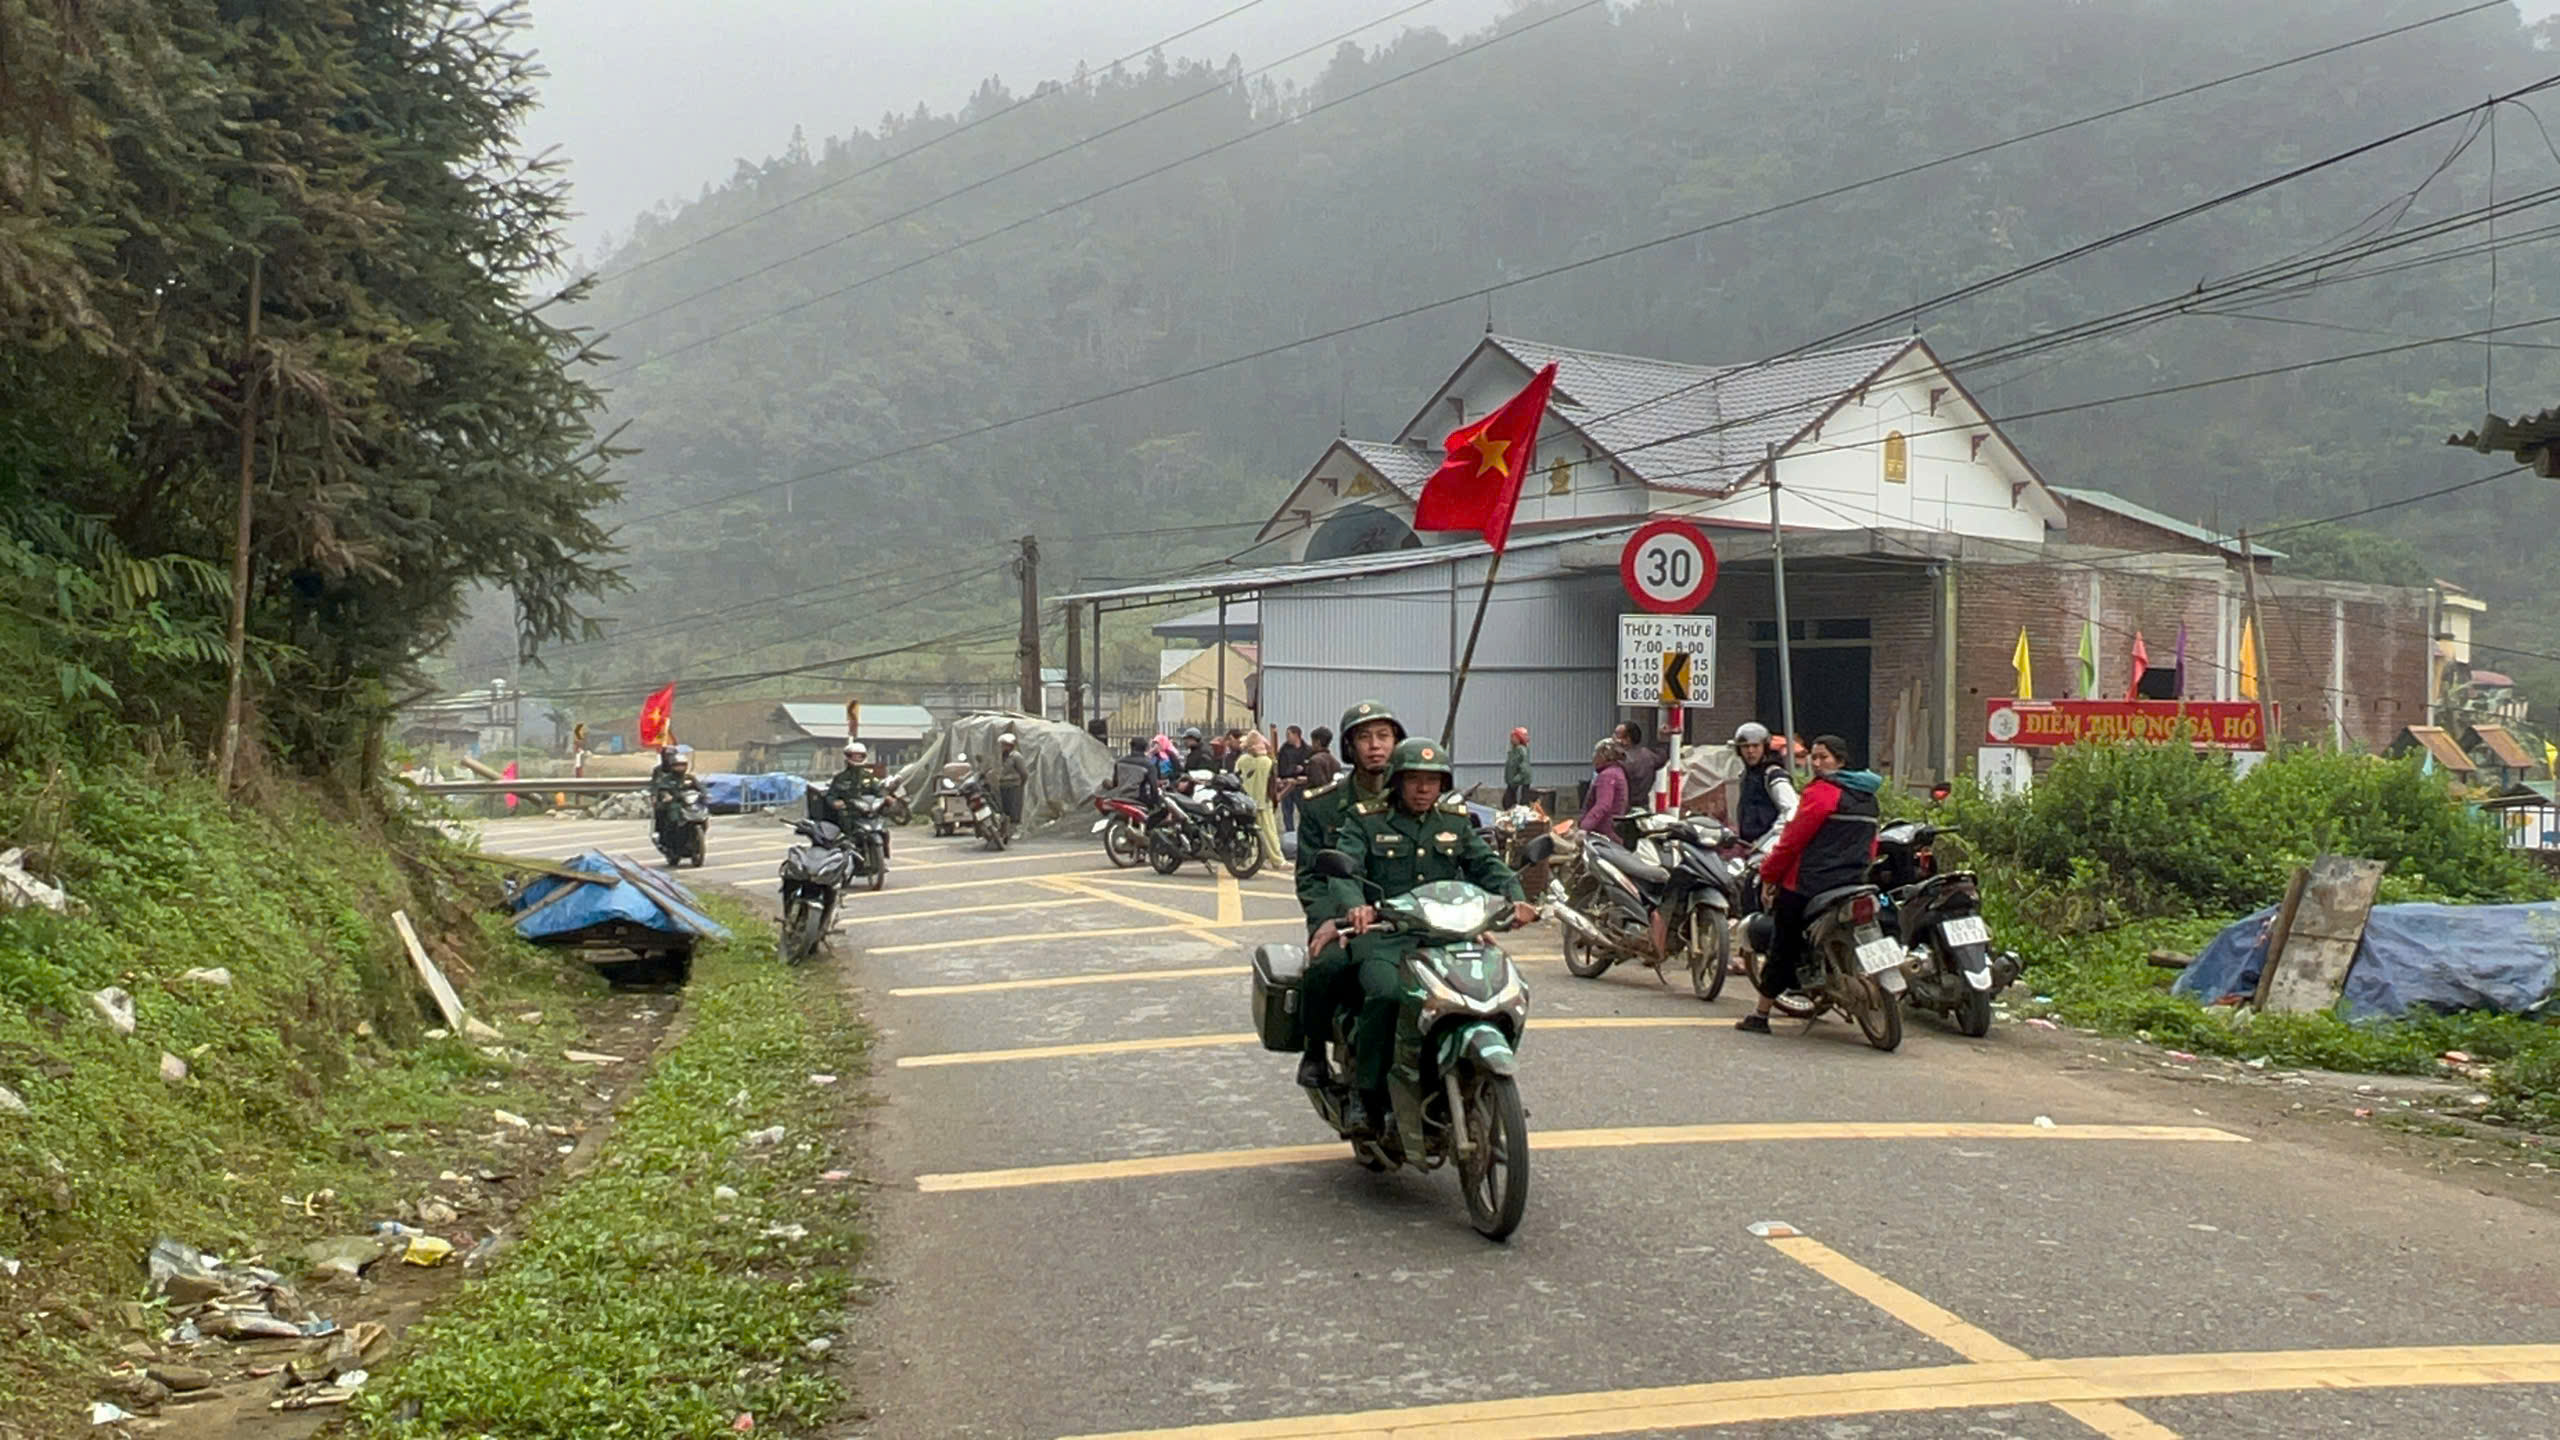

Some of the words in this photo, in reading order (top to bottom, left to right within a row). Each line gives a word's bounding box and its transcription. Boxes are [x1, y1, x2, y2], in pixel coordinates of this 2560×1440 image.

[1647, 548, 1691, 587] 30
[1624, 620, 1652, 636] THỨ
[1655, 624, 1663, 636] 2
[1673, 621, 1702, 637] THỨ
[1705, 624, 1712, 637] 6
[1633, 640, 1663, 653] 7:00
[1623, 657, 1659, 670] 11:15
[1623, 673, 1659, 685] 13:00
[1623, 688, 1659, 700] 16:00
